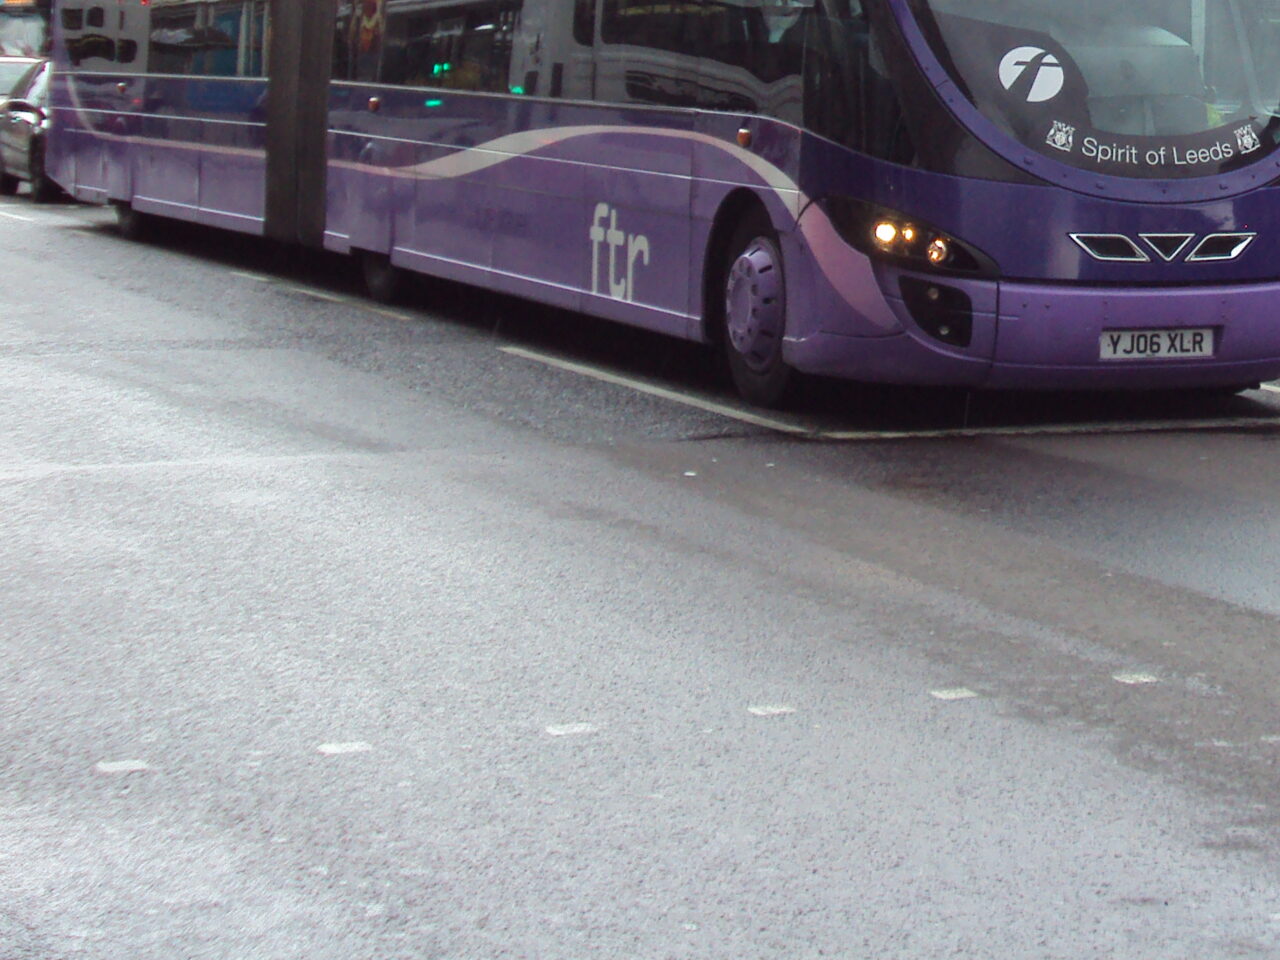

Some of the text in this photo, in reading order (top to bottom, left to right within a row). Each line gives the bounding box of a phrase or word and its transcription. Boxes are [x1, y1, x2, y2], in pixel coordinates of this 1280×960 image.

[1081, 137, 1233, 166] Spirit of Leeds
[590, 203, 649, 302] ftr
[1109, 332, 1204, 354] YJ06 XLR
